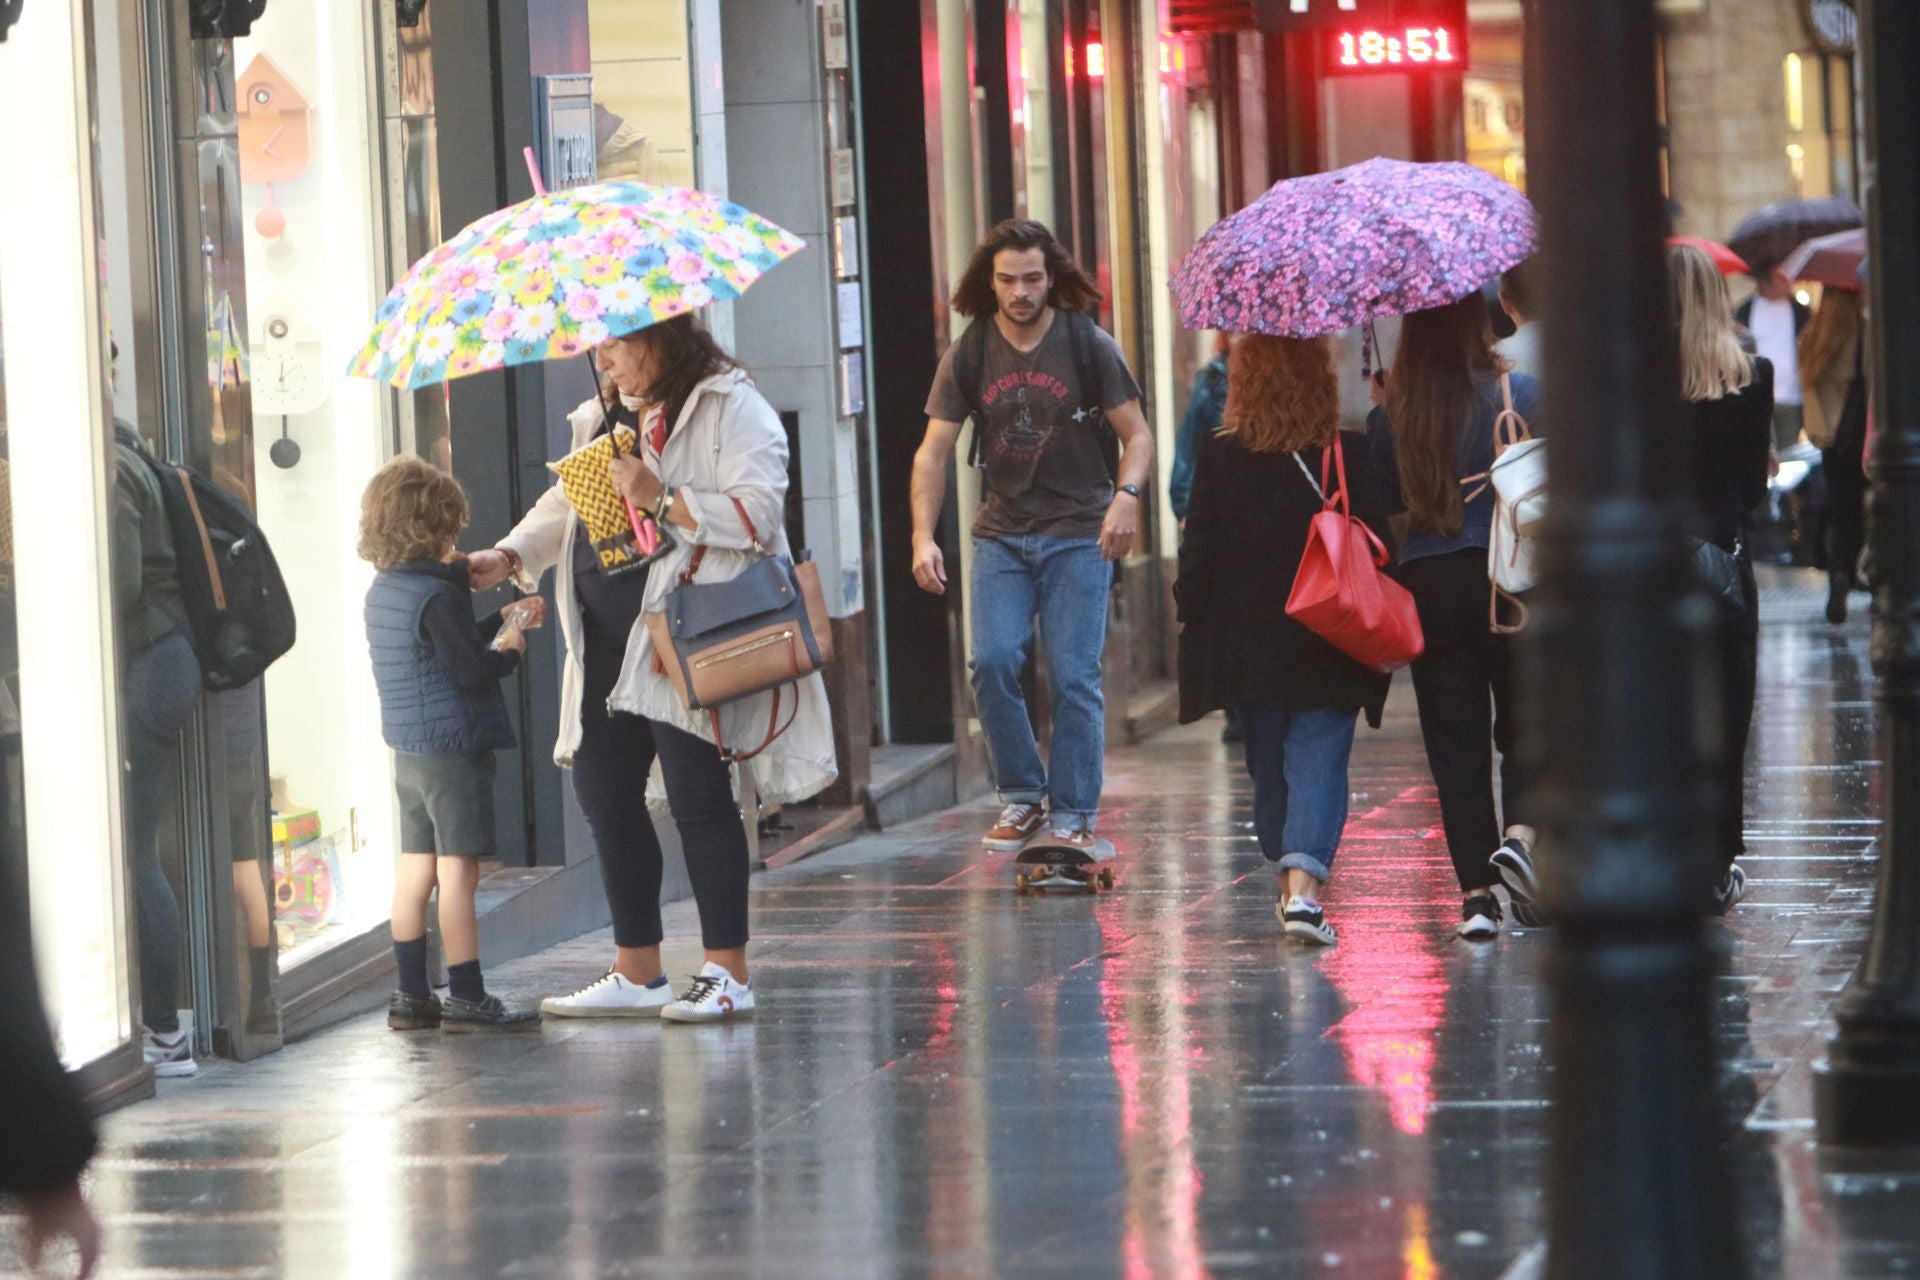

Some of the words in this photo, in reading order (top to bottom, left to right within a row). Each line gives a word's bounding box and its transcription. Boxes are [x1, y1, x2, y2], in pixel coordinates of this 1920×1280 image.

[1340, 28, 1453, 65] 18:51
[983, 384, 999, 405] RIP
[1026, 371, 1056, 387] SURF
